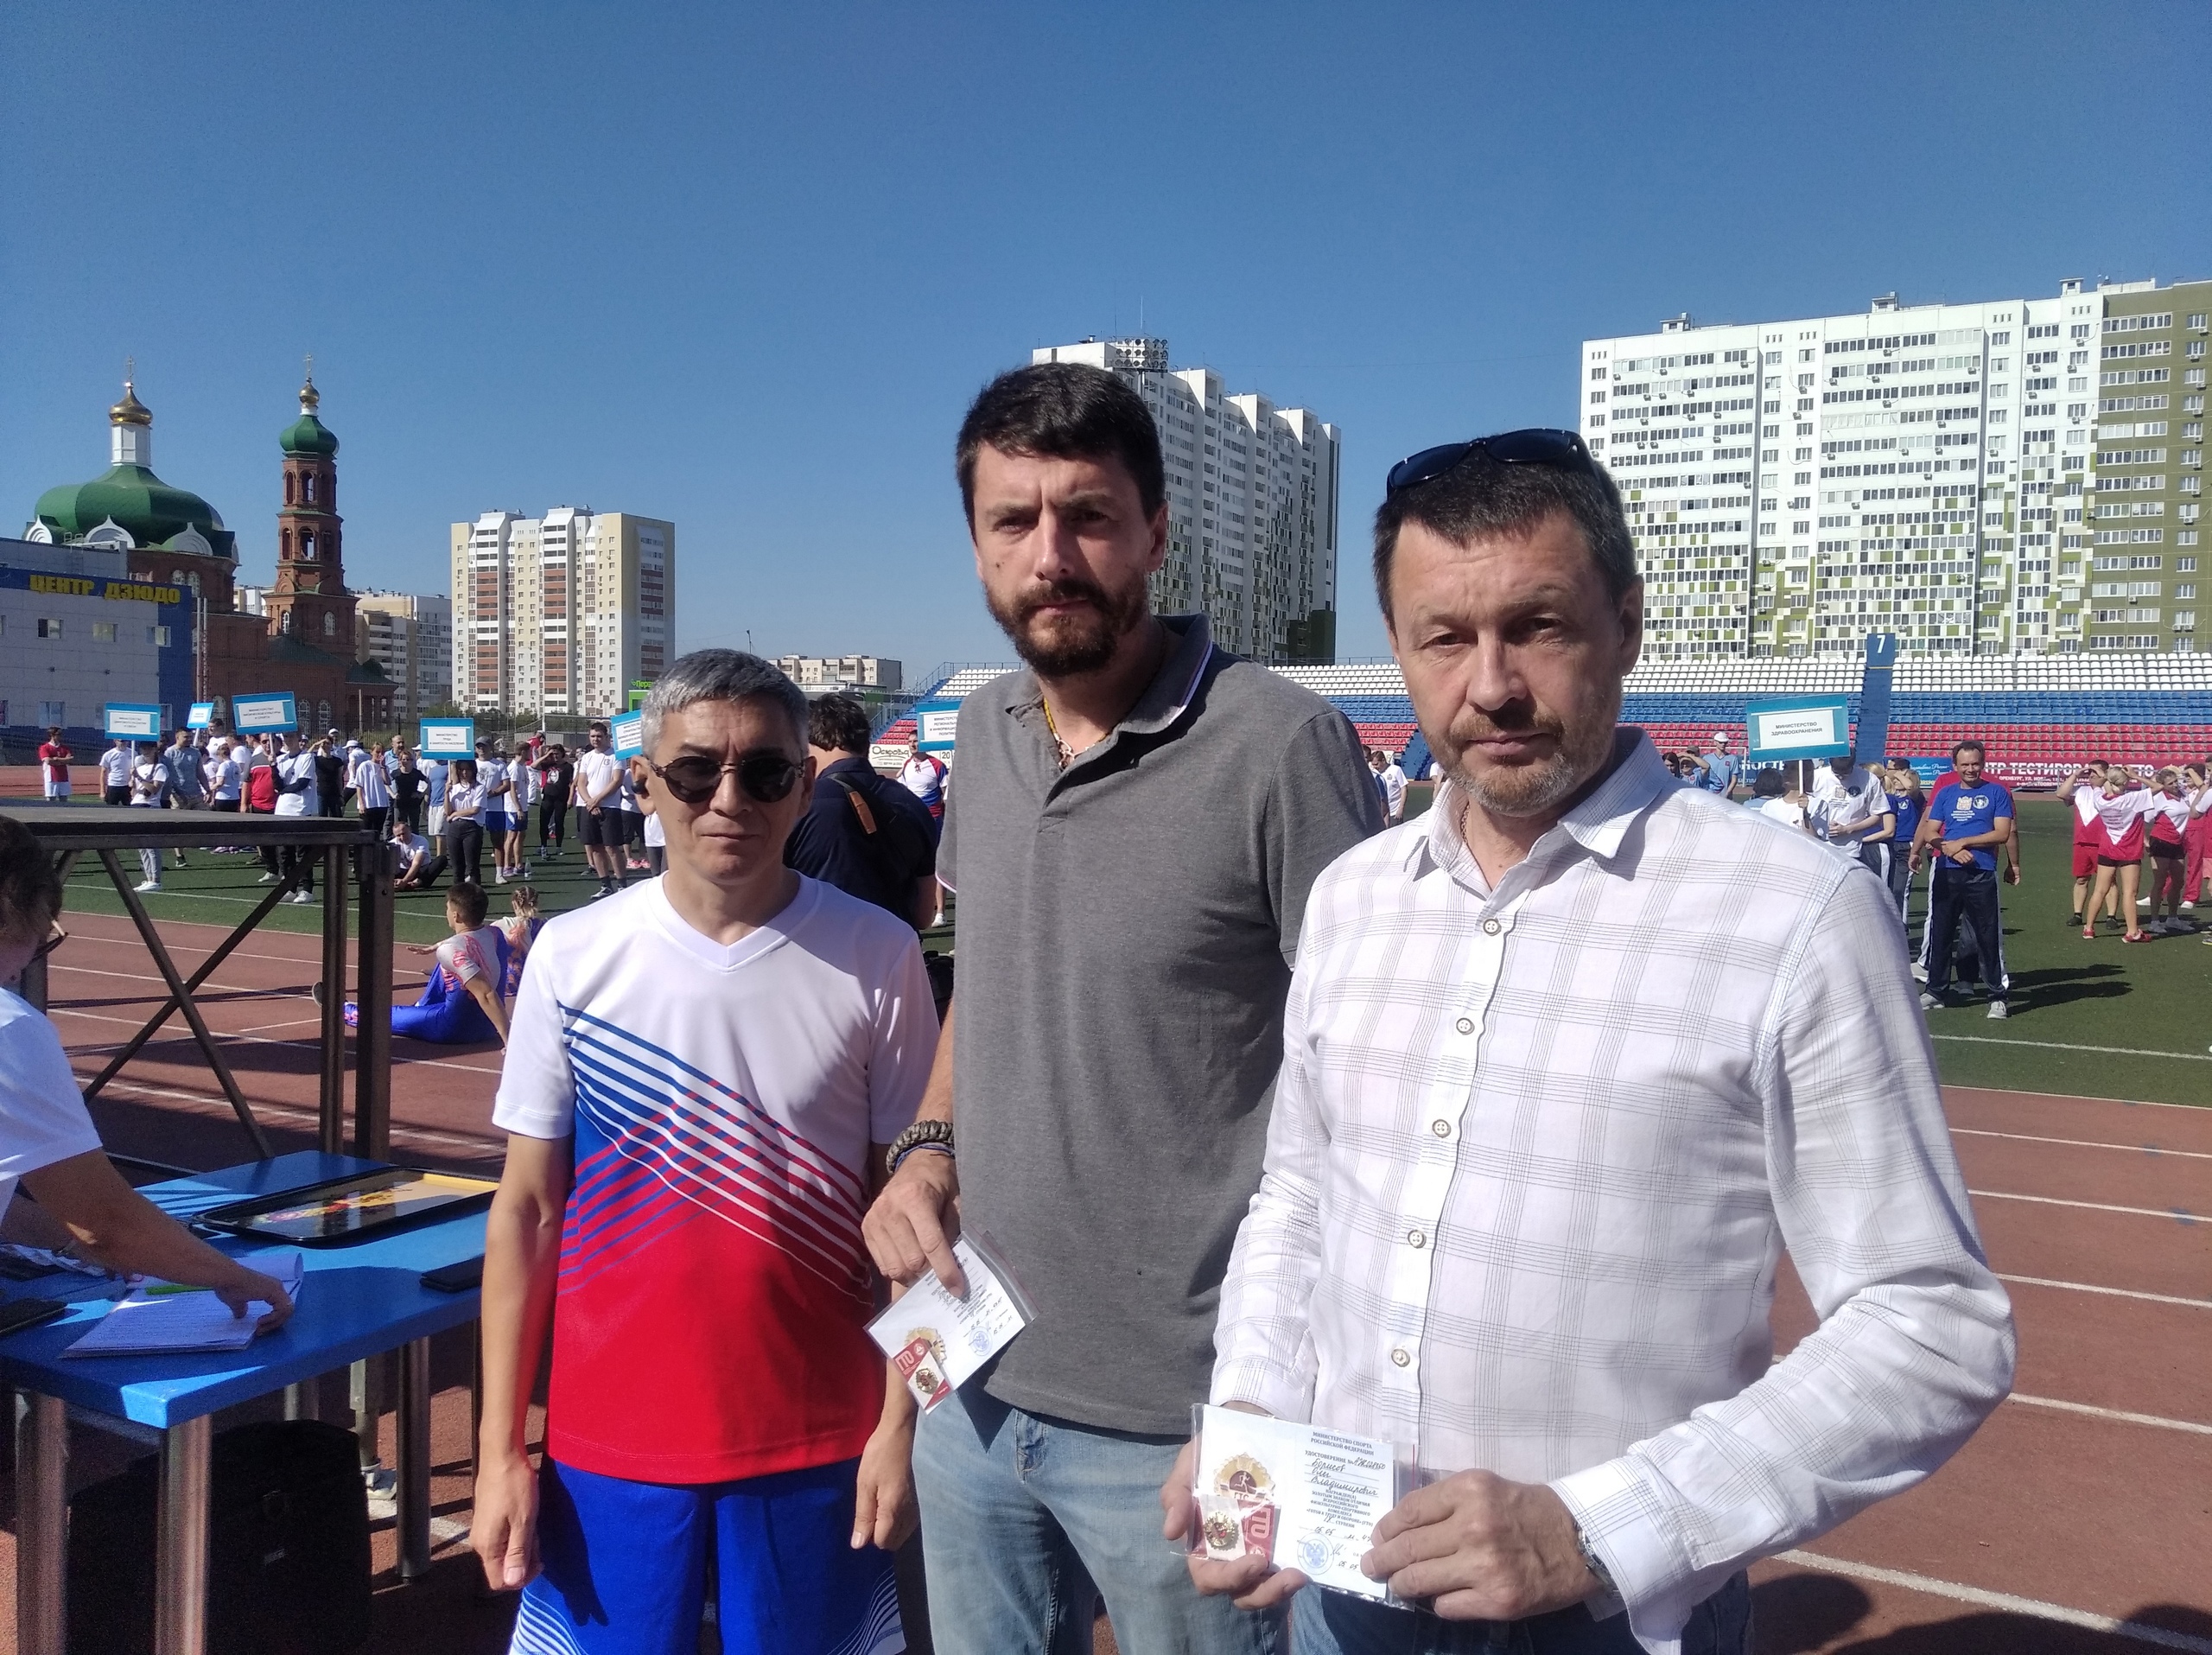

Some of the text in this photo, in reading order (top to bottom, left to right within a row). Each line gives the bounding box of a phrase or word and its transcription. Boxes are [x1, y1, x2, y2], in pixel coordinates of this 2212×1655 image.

[29, 575, 181, 604] ЦЕНТР ДЗЮДО
[1877, 635, 1886, 653] 7
[1771, 728, 1823, 736] ЗДРАВООХРАНЕНИЯ
[1311, 1437, 1375, 1456] РОССИЙСКОЙ ФЕДЕРАЦИИ
[1313, 1431, 1373, 1449] МИНИСТЕРСТВО СПОРТА
[1305, 1450, 1346, 1464] УДОСТОВЕРЕНИЕ
[1312, 1458, 1346, 1472] Борисов
[1311, 1475, 1378, 1496] Владимирович
